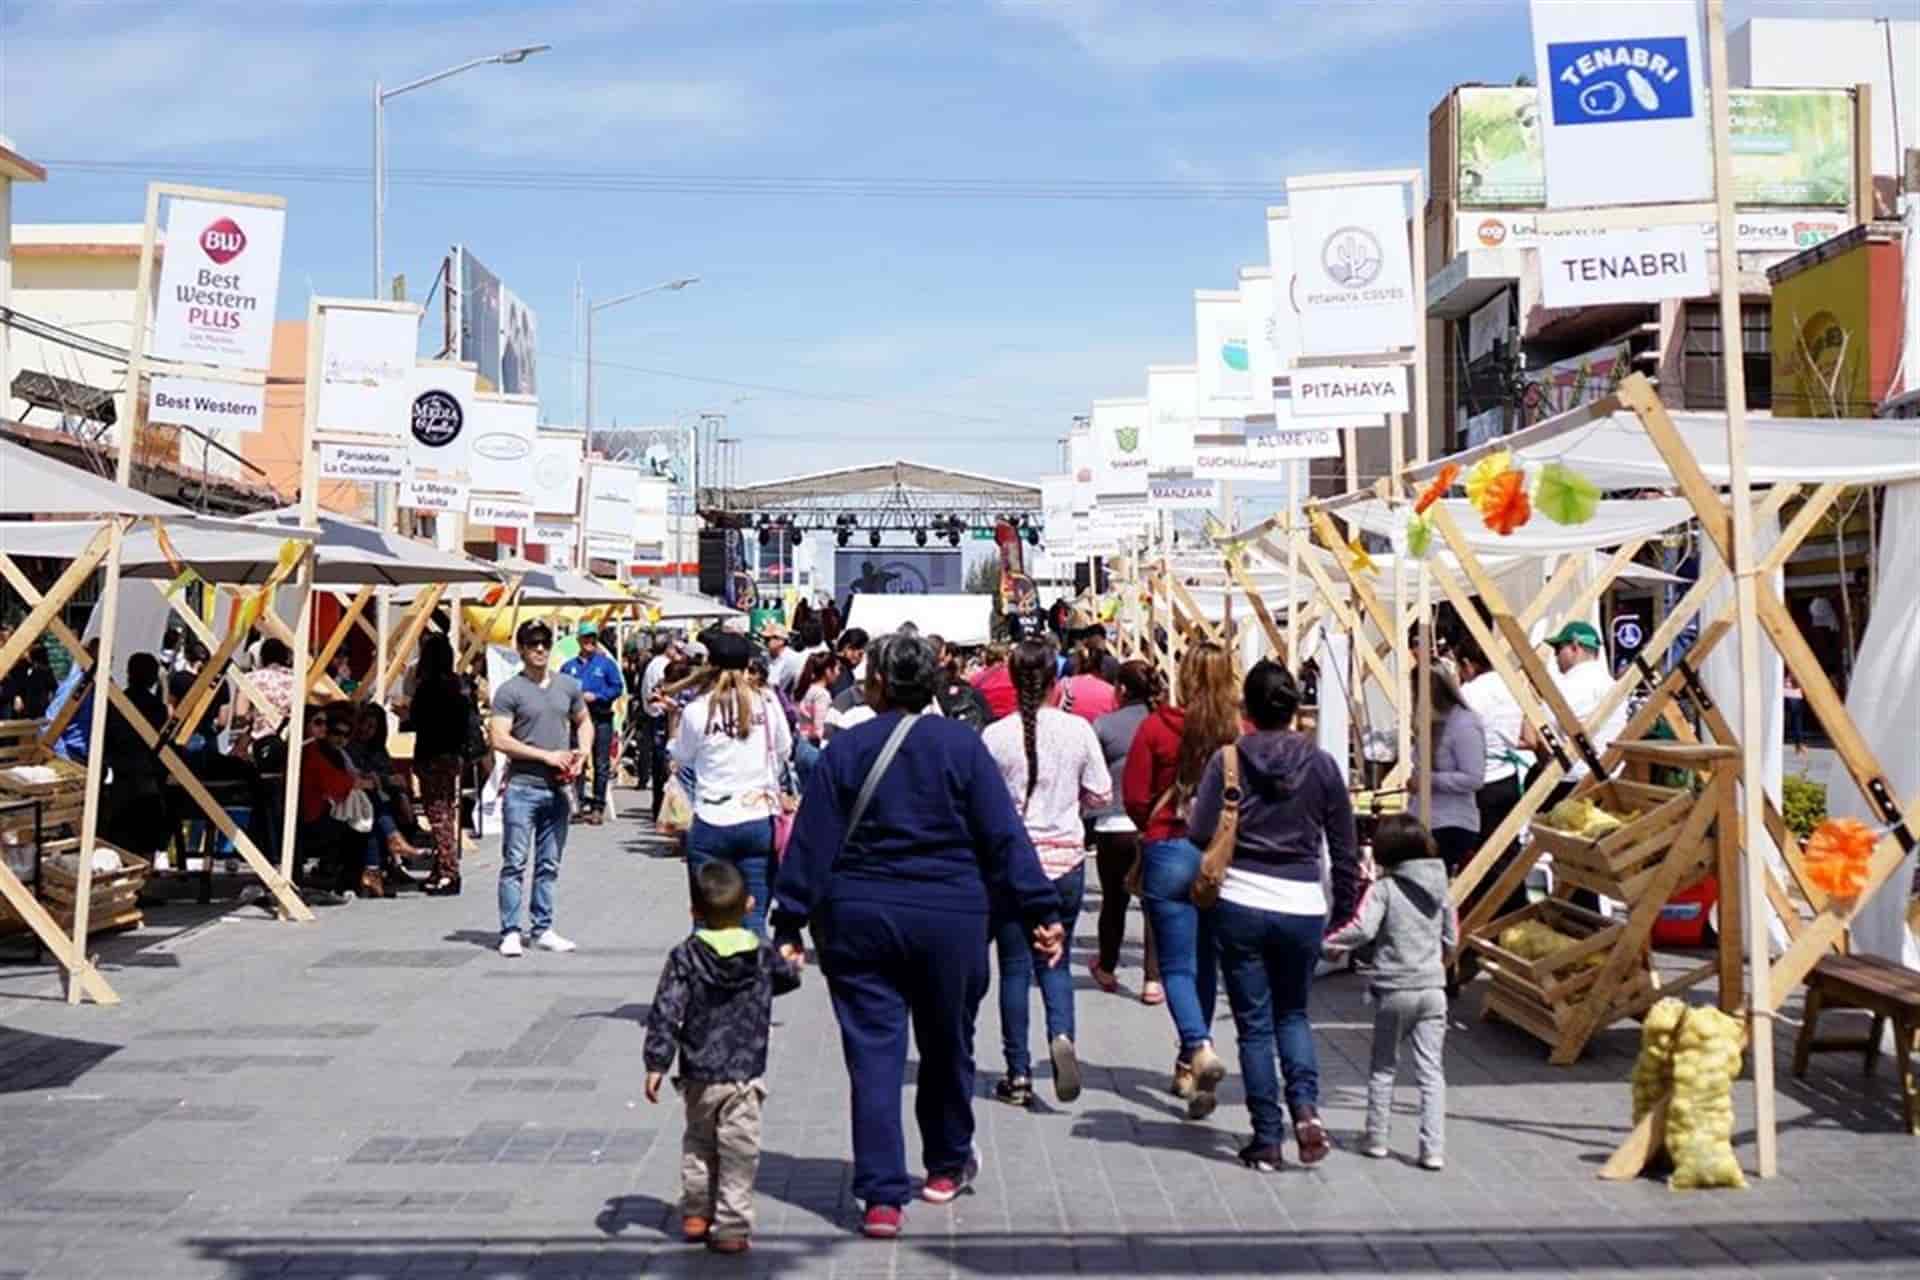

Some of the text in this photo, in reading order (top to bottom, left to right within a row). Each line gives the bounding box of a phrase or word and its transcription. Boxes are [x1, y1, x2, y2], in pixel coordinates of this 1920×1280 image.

[1561, 46, 1679, 86] TENABRI
[1738, 224, 1788, 236] Directa
[206, 231, 241, 252] BW
[1562, 252, 1688, 282] TENABRI
[197, 269, 241, 290] Best
[176, 285, 256, 311] Western
[188, 307, 241, 329] PLUS
[1302, 381, 1396, 400] PITAHAYA
[155, 392, 257, 416] Best Western
[324, 463, 400, 476] La Canadiense
[410, 483, 456, 496] La Media
[417, 496, 447, 507] Vuelta
